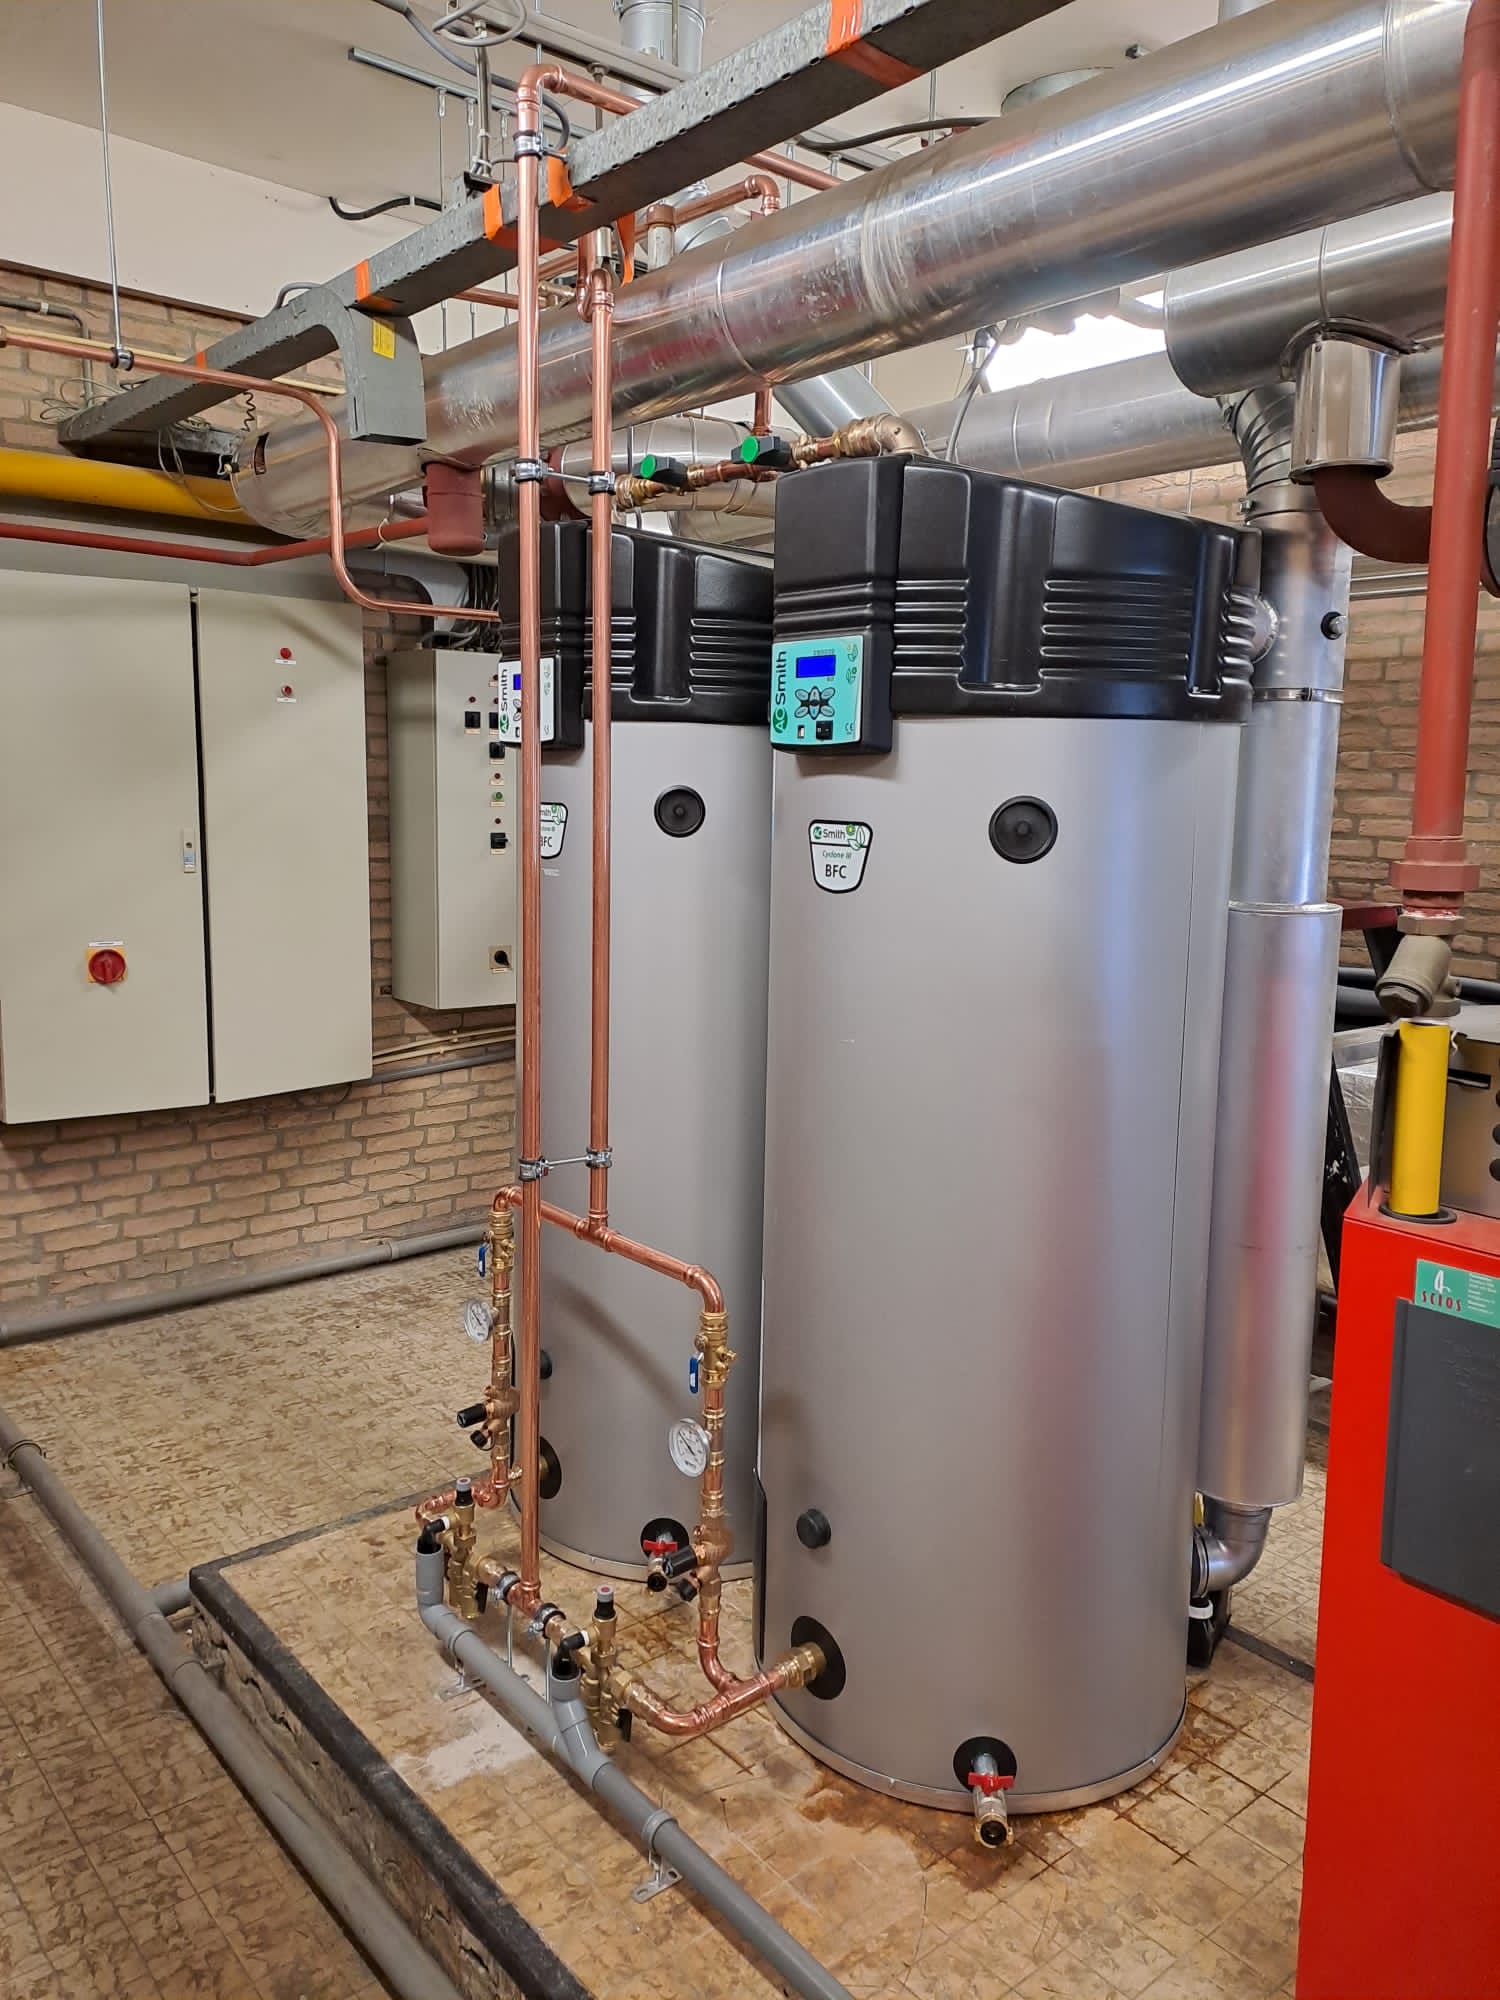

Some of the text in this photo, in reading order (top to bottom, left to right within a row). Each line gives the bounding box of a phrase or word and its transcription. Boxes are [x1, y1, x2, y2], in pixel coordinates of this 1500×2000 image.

[776, 651, 787, 705] Smith
[823, 829, 846, 840] Smith
[825, 863, 847, 879] BFC
[1422, 1290, 1462, 1312] SCIOS
